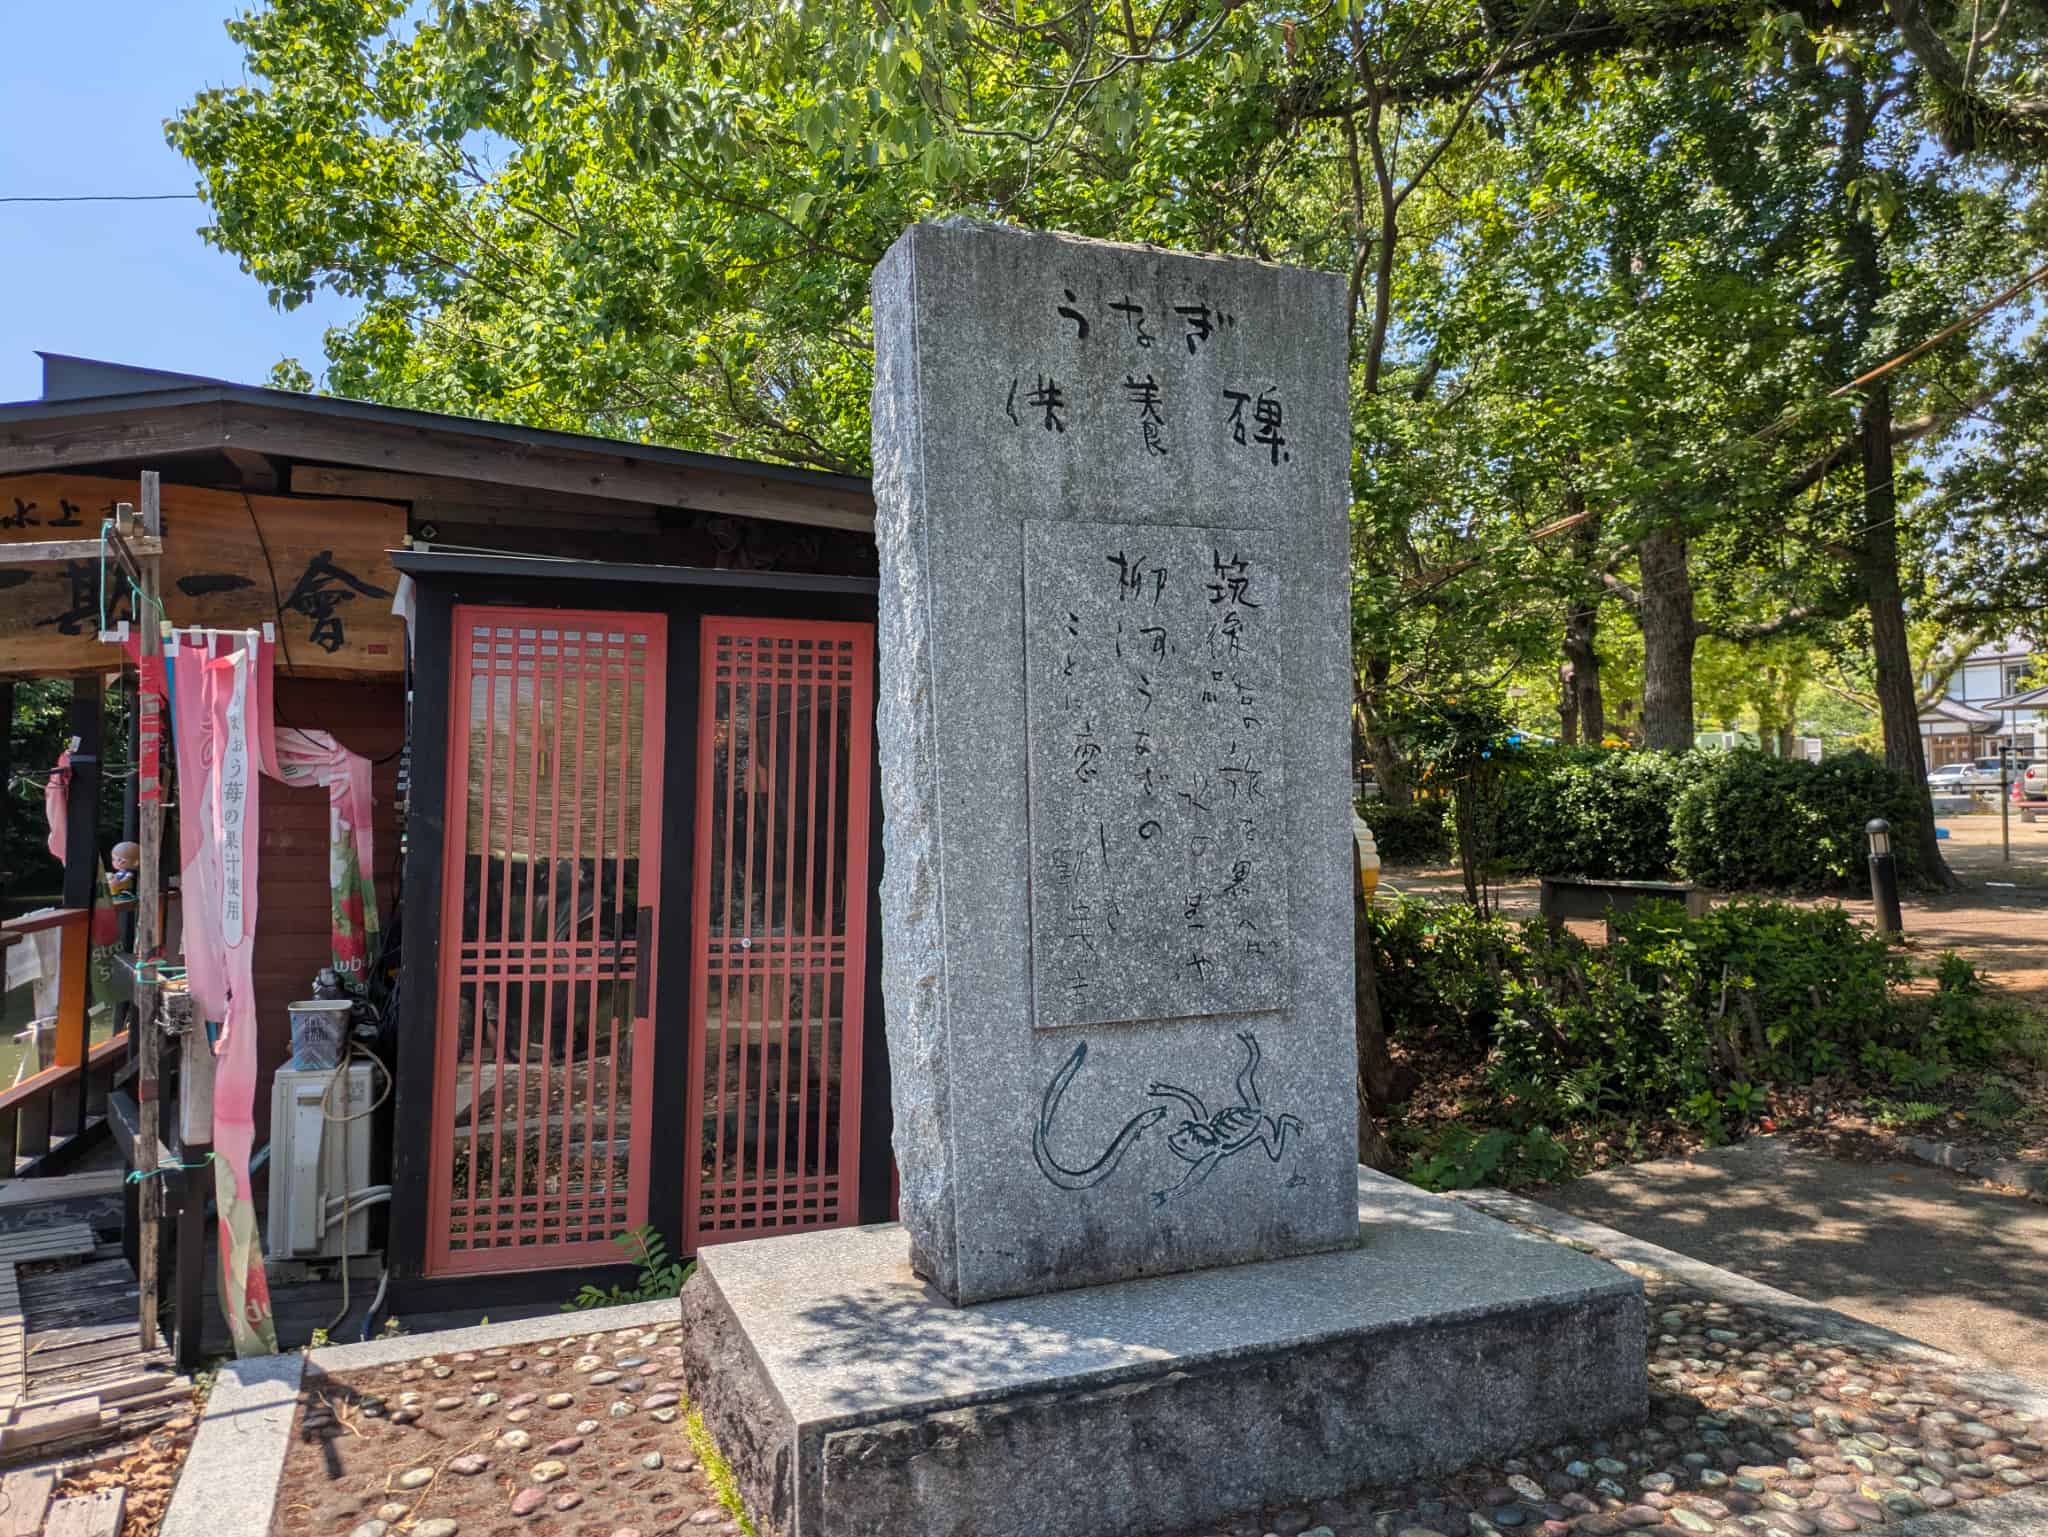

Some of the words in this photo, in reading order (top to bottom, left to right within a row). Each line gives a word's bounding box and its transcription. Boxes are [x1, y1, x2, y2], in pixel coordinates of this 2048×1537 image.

[1057, 288, 1234, 356] うなぎ
[1005, 373, 1290, 467] 供養碑
